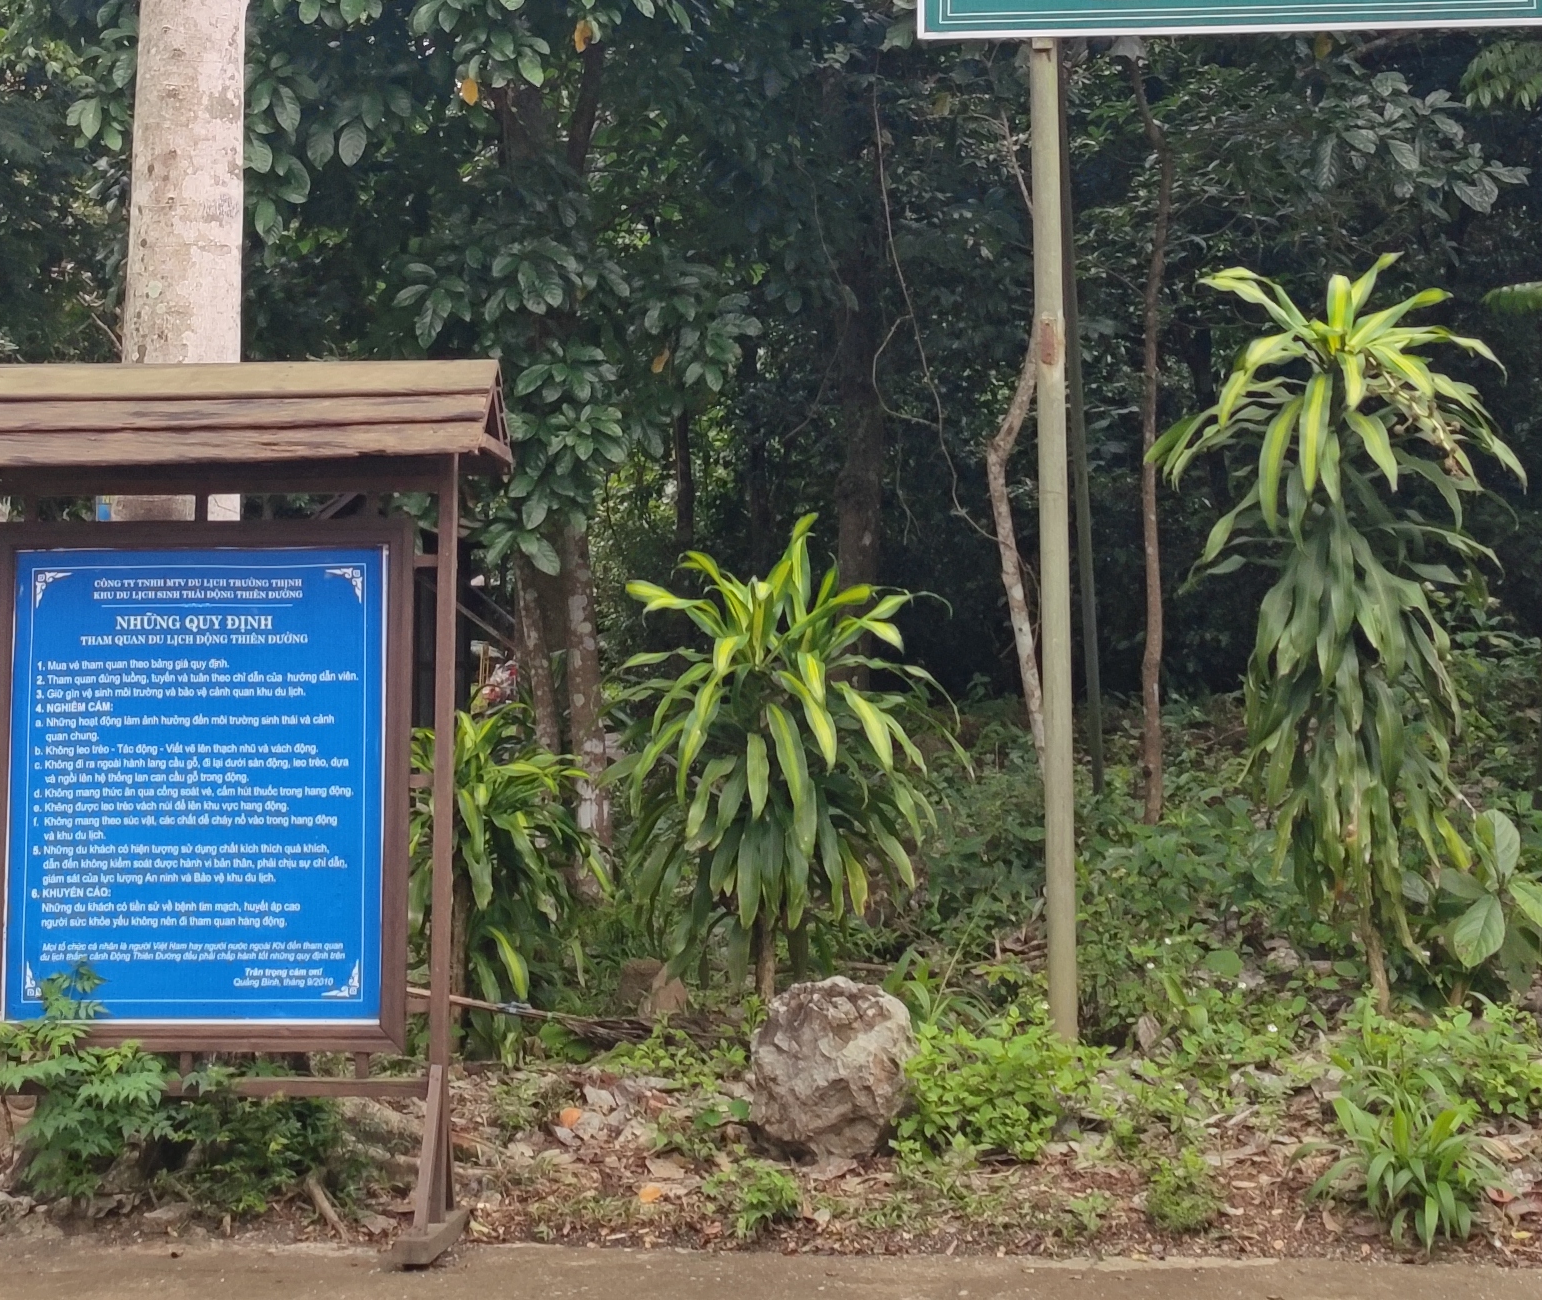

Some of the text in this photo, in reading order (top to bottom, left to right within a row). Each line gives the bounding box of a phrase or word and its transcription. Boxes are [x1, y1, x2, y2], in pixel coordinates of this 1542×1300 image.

[116, 612, 272, 632] NHỮNG QUY ĐỊNH
